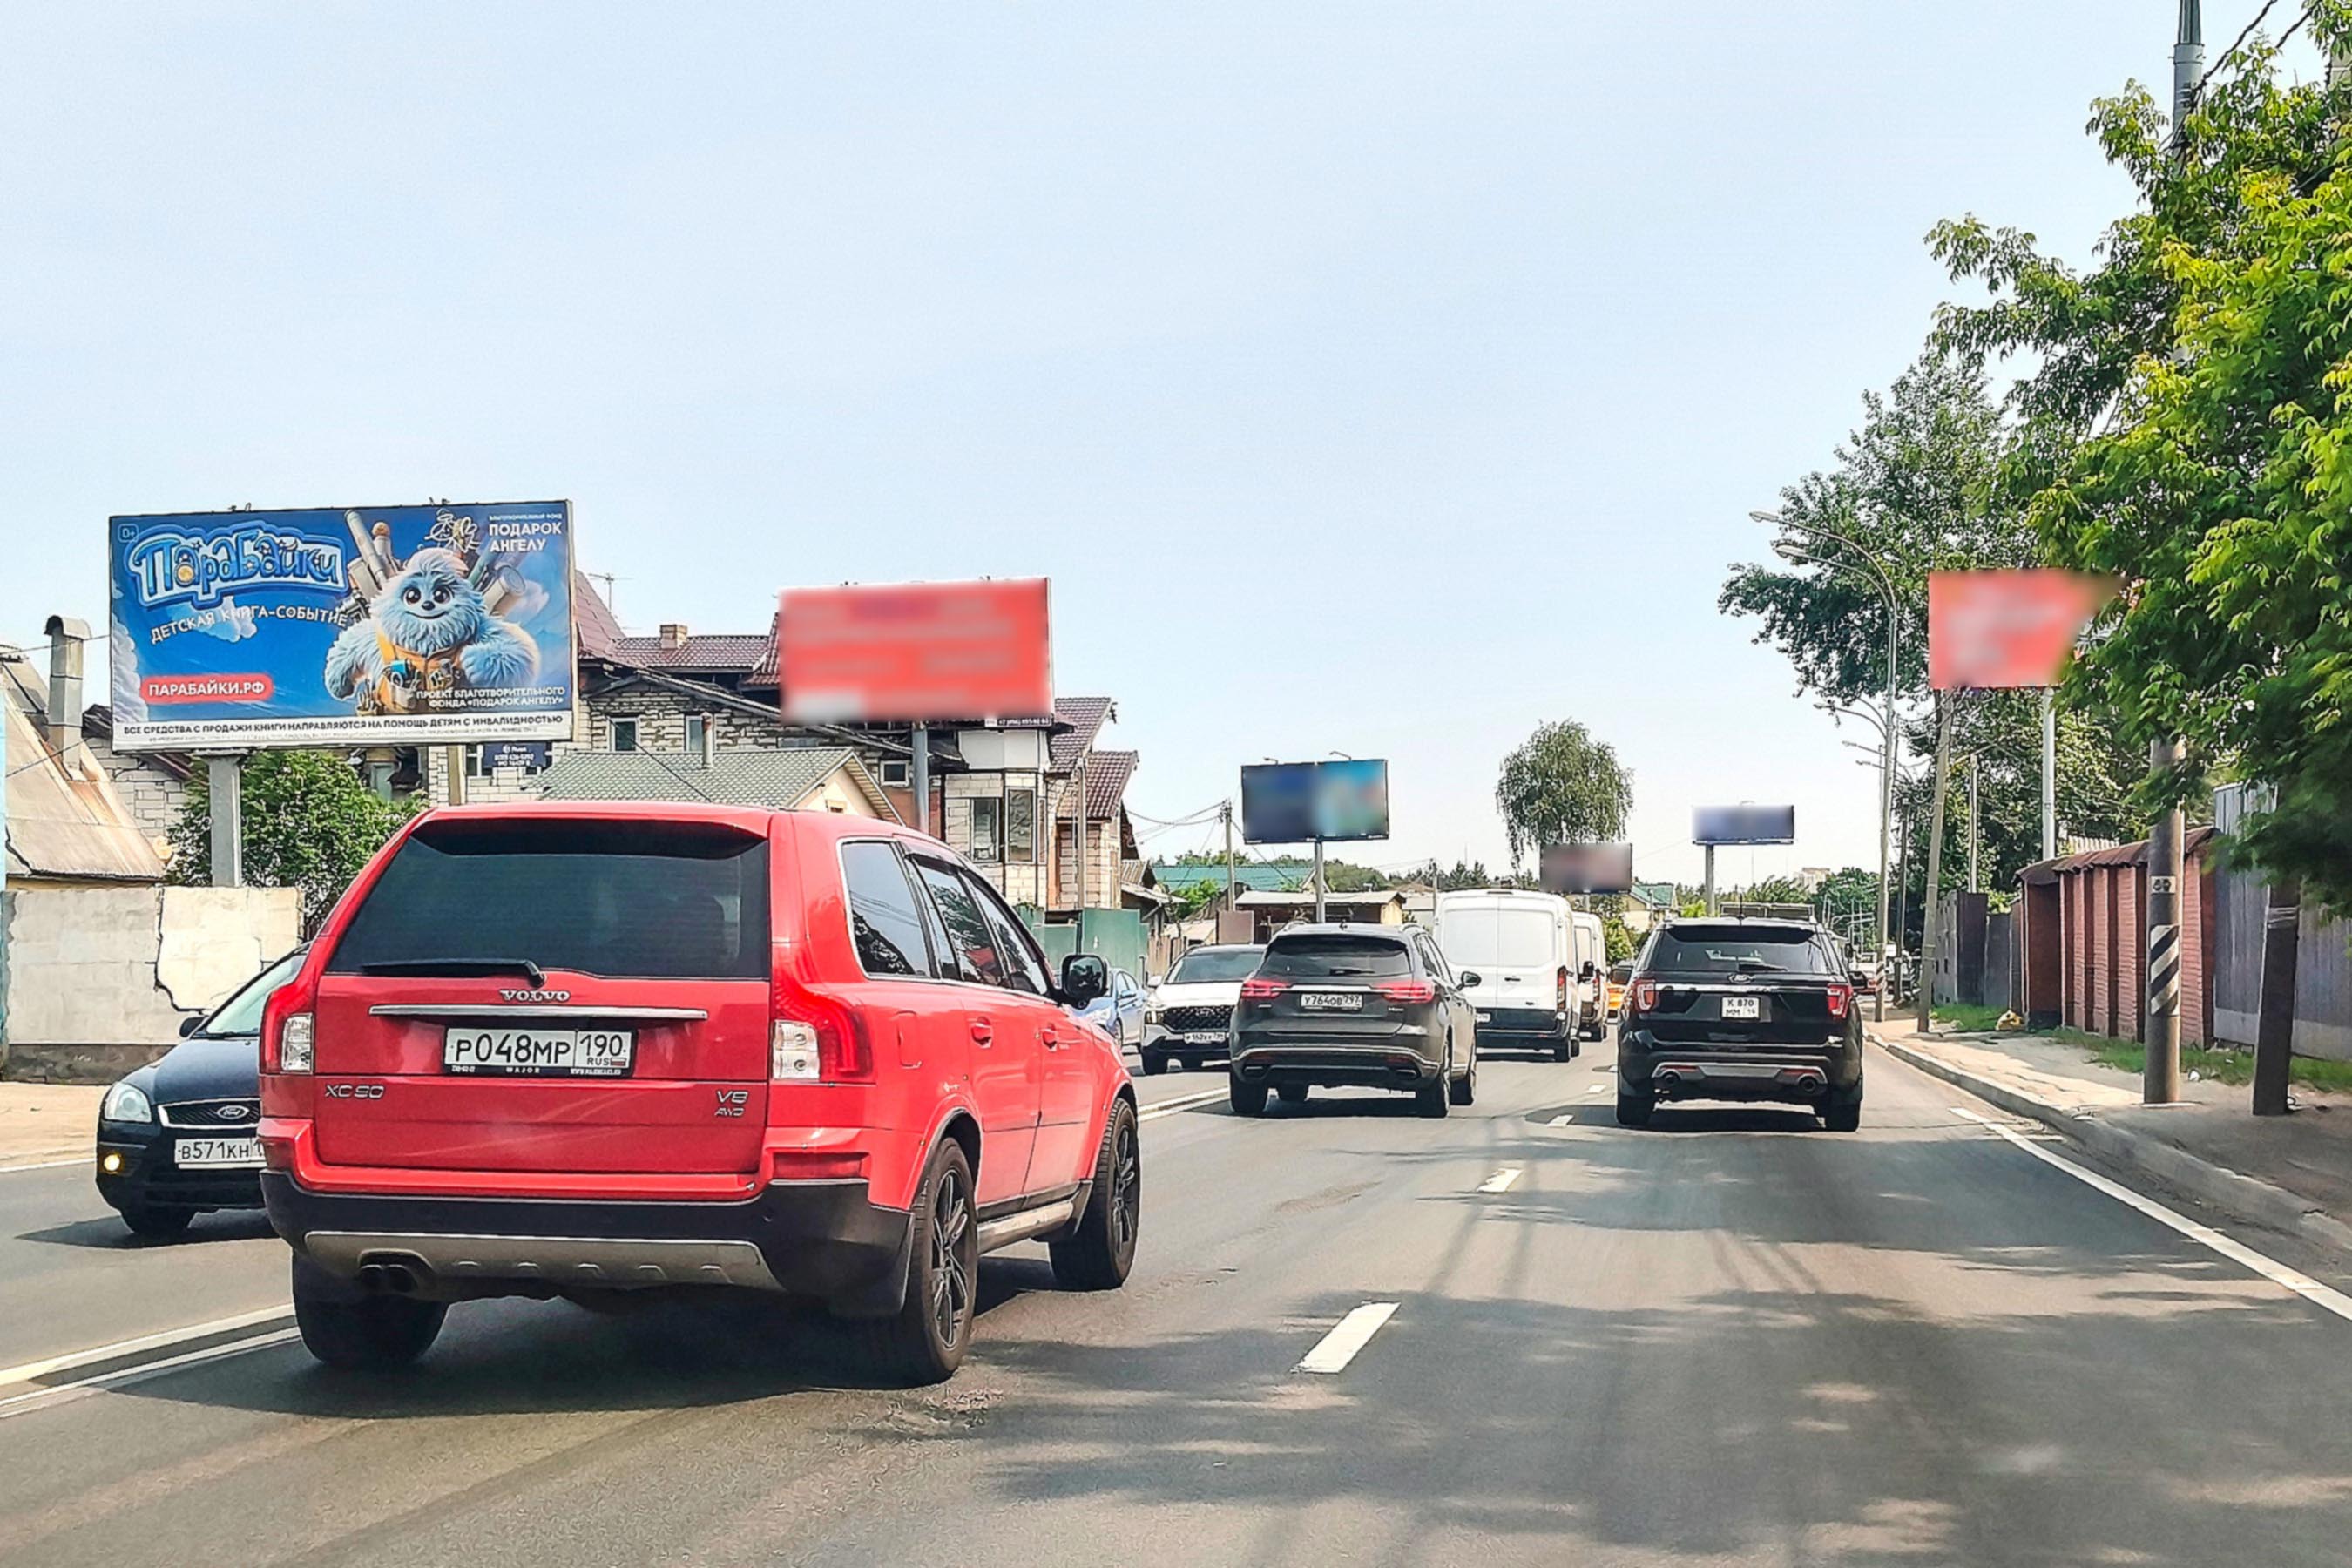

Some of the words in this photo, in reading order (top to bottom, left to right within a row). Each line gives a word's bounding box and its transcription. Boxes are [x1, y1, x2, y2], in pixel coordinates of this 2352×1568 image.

[489, 523, 562, 537] ПОДАРОК
[490, 538, 546, 552] АНГЕЛУ
[151, 612, 215, 644] ДЕТСКАЯ
[221, 605, 348, 628] КНИГА-СОБЫТИЕ
[148, 680, 265, 697] ПАРАБАЙКИ.РФ
[124, 727, 141, 735] ВСЕ
[144, 725, 192, 734] СРЕДСТВА
[202, 724, 252, 733] ПРОДАЖИ
[253, 723, 286, 732] КНИГИ
[287, 720, 367, 732] НАПРАВЛЯЮТСЯ
[383, 720, 429, 729] ПОМОЩЬ
[430, 719, 462, 727] ДЕТЯМ
[473, 715, 563, 726] ИНВАЛИДНОСТЬЮ
[499, 990, 571, 1001] VOLVO
[579, 1034, 623, 1056] 190
[587, 1057, 610, 1066] RUS
[717, 1091, 748, 1103] V8
[714, 1107, 745, 1116] AWD
